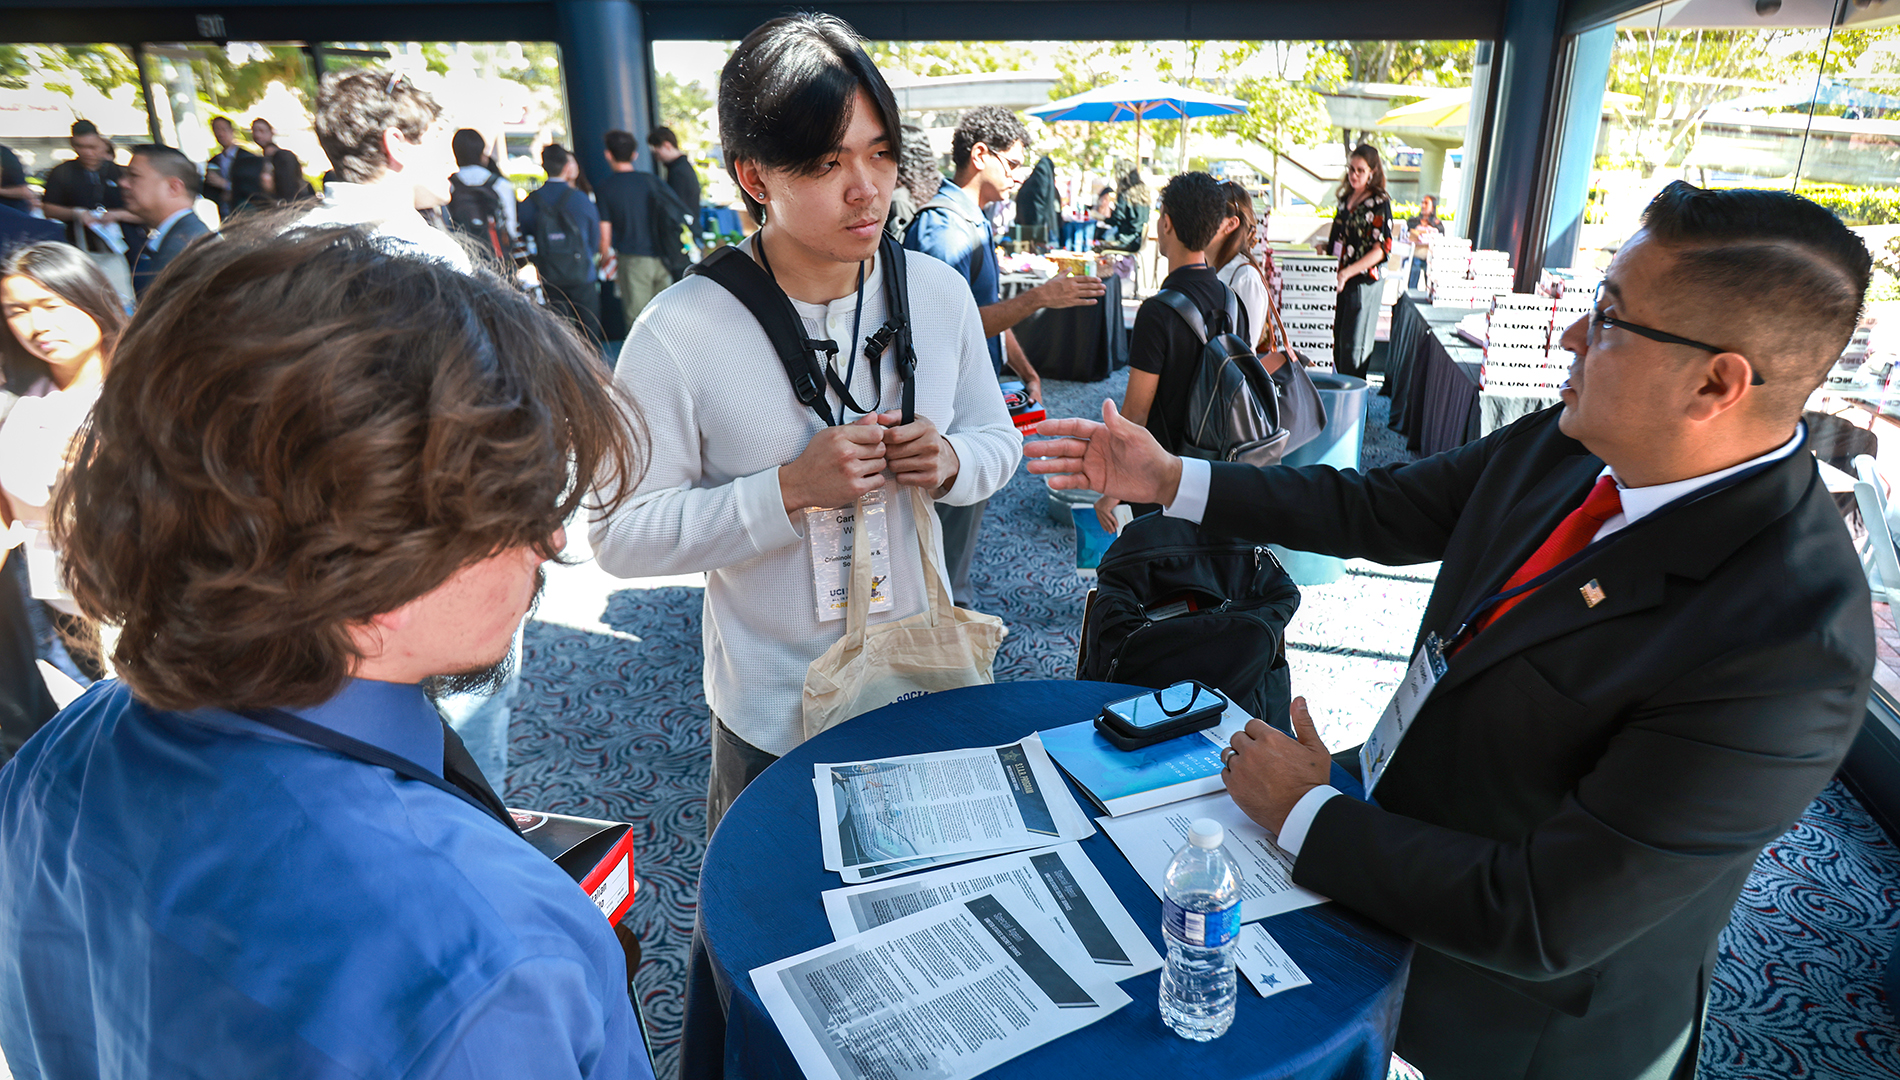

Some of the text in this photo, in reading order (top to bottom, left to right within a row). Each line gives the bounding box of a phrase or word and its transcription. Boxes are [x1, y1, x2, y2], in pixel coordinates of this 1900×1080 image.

[1295, 284, 1337, 292] LUNCH
[1292, 322, 1333, 330] LUNCH
[1292, 341, 1334, 349] LUNCH
[836, 514, 855, 524] Cart
[830, 588, 845, 597] UCI
[1184, 753, 1209, 772] FUTURE
[1204, 756, 1221, 769] INTO
